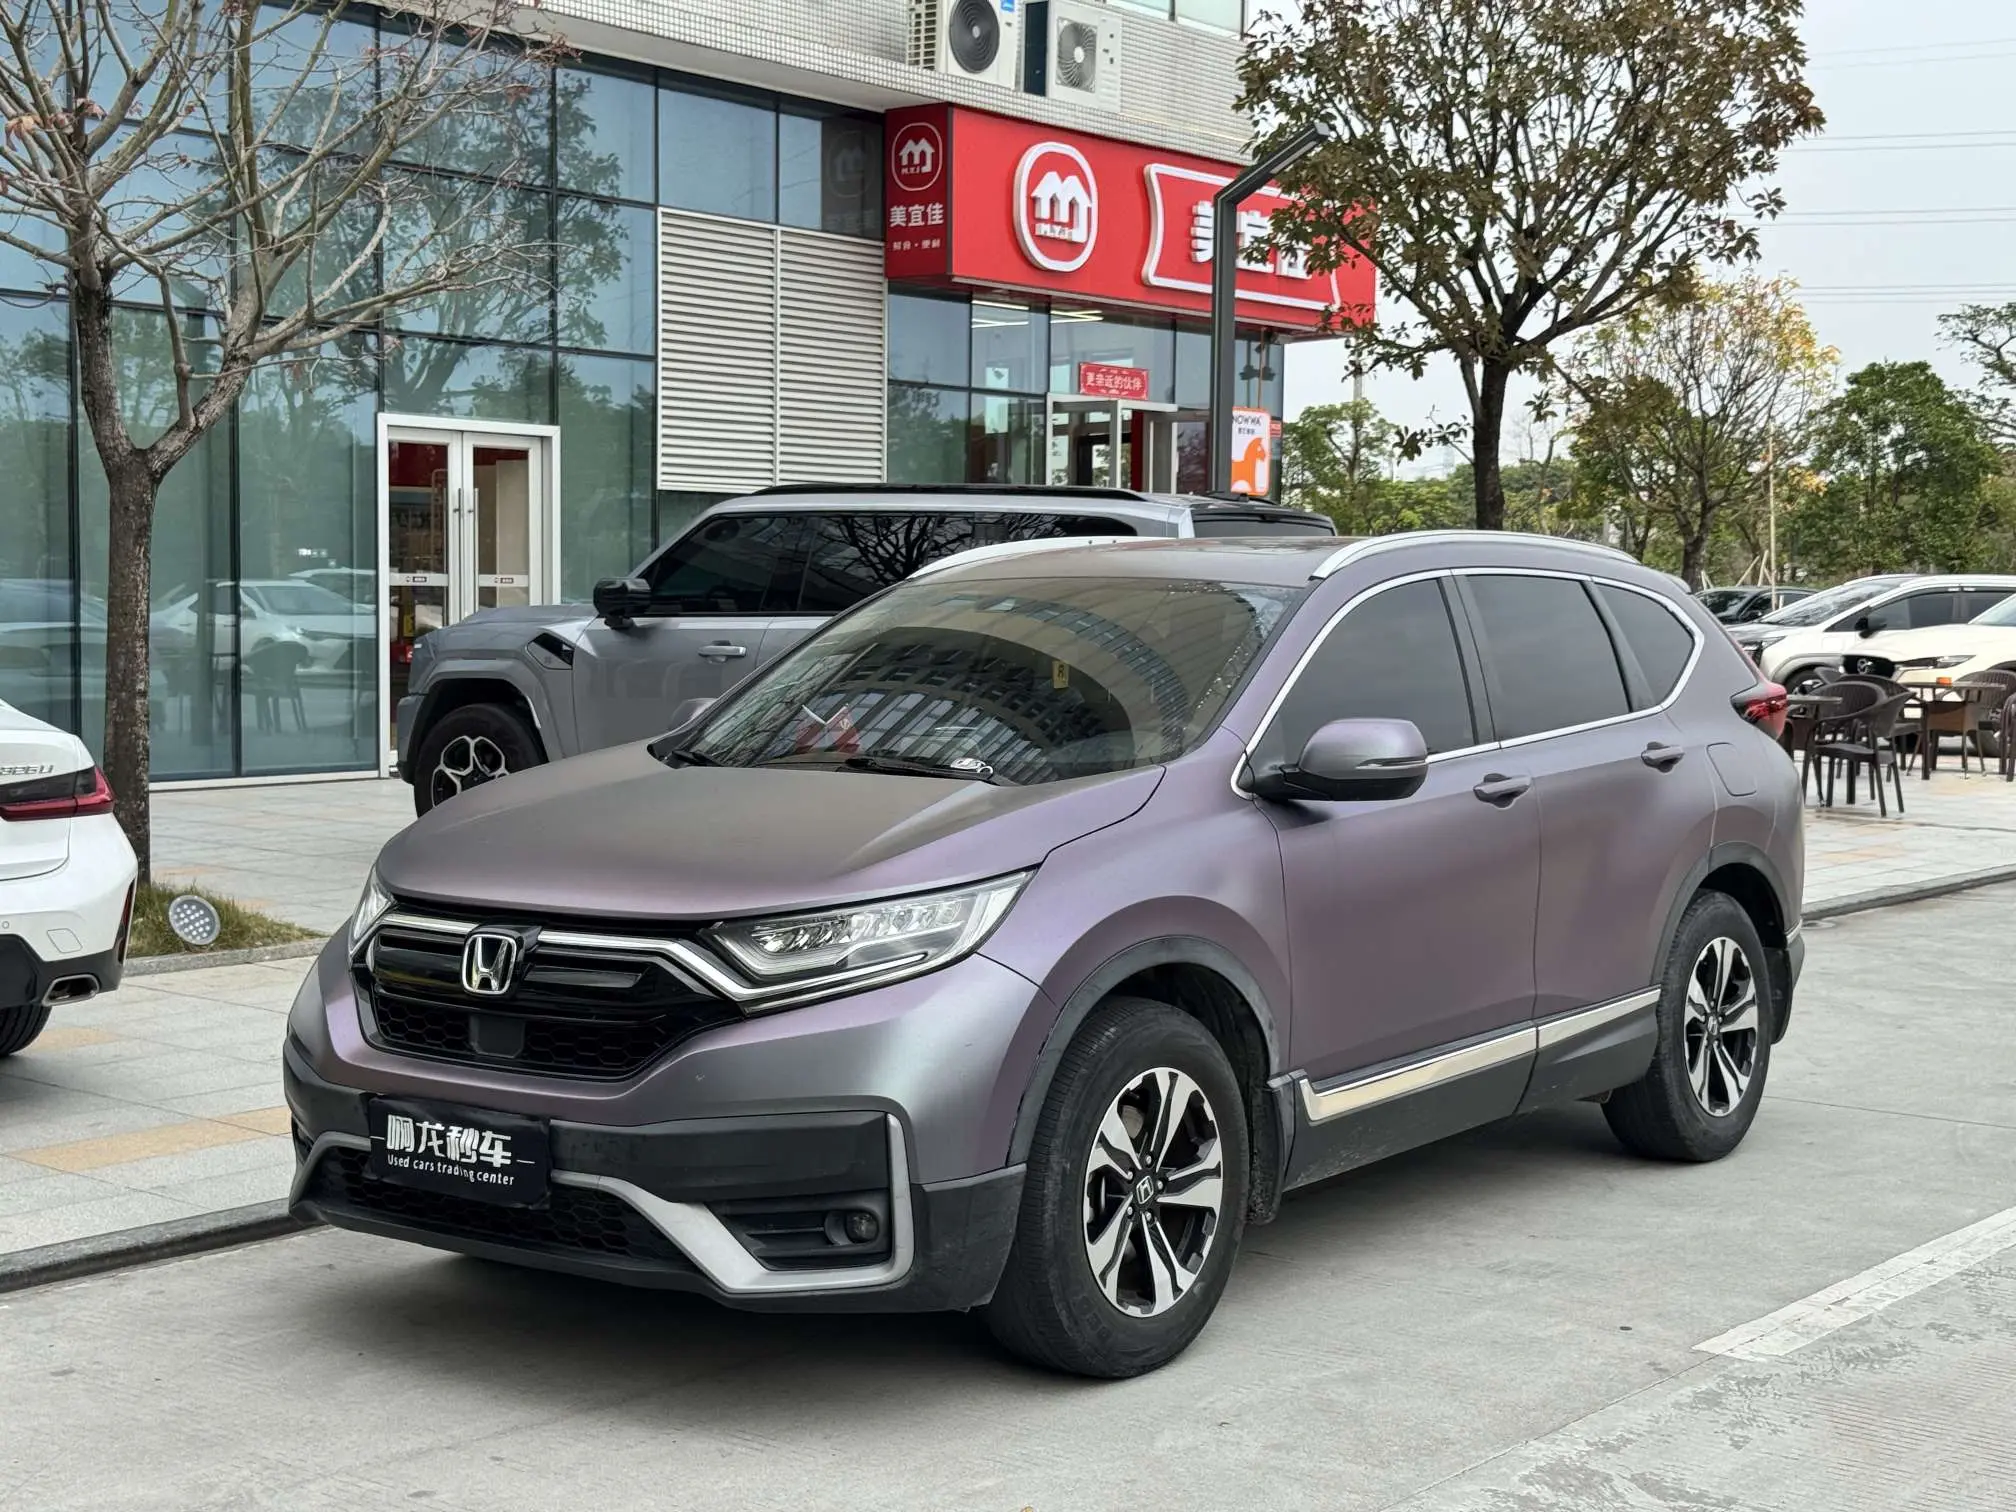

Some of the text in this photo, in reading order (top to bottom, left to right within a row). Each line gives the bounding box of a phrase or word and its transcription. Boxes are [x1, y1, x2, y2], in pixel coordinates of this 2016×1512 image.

[890, 202, 944, 227] 美宜佳
[387, 1154, 515, 1186] Used cars trading center
